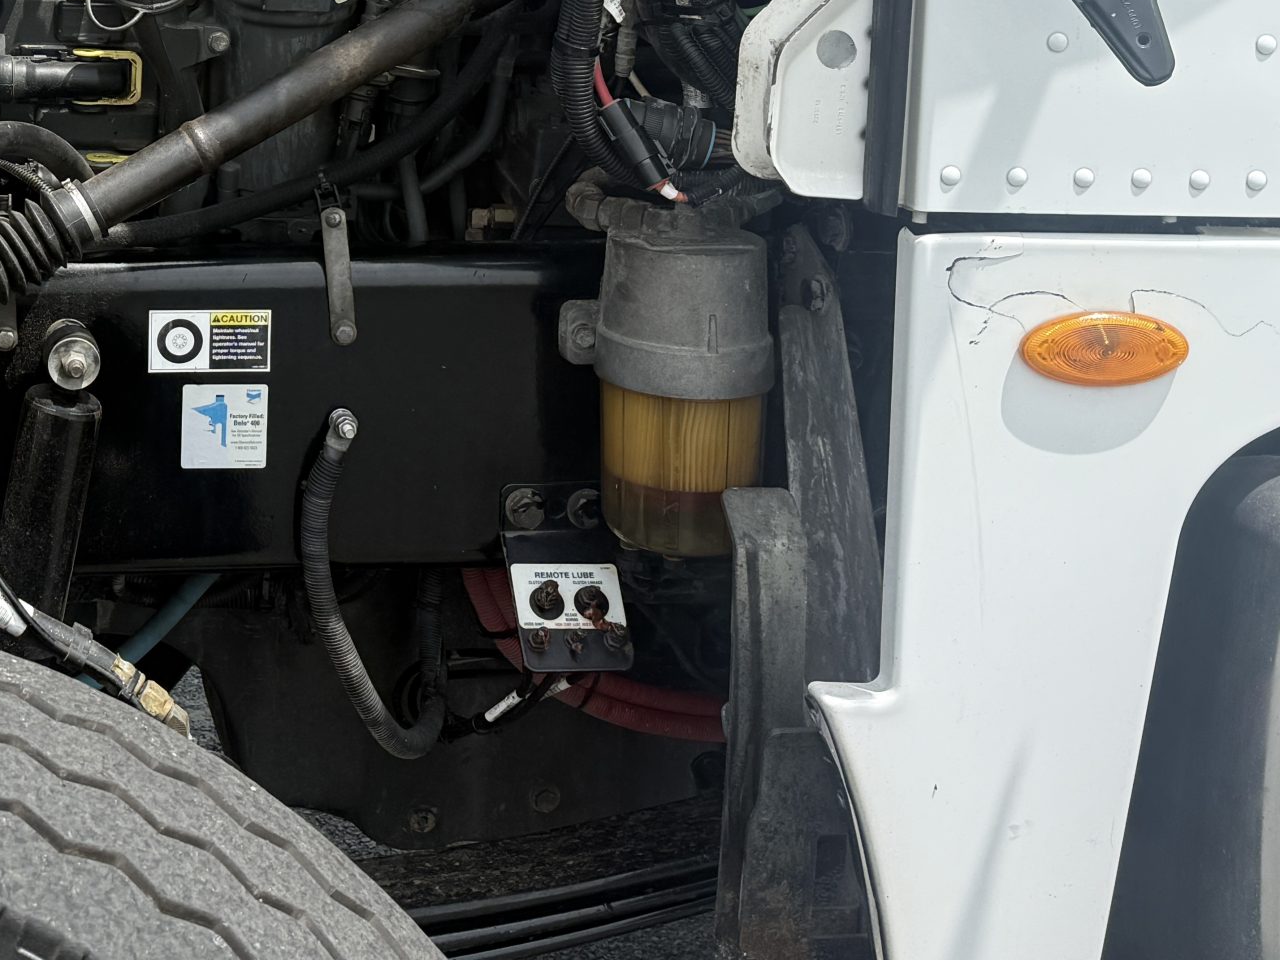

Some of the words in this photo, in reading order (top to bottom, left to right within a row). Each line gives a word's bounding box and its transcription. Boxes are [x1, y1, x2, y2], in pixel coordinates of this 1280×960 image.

[221, 314, 268, 323] CAUTION
[229, 412, 248, 420] Factory
[534, 571, 570, 579] REMOTE
[572, 571, 595, 579] LUBE
